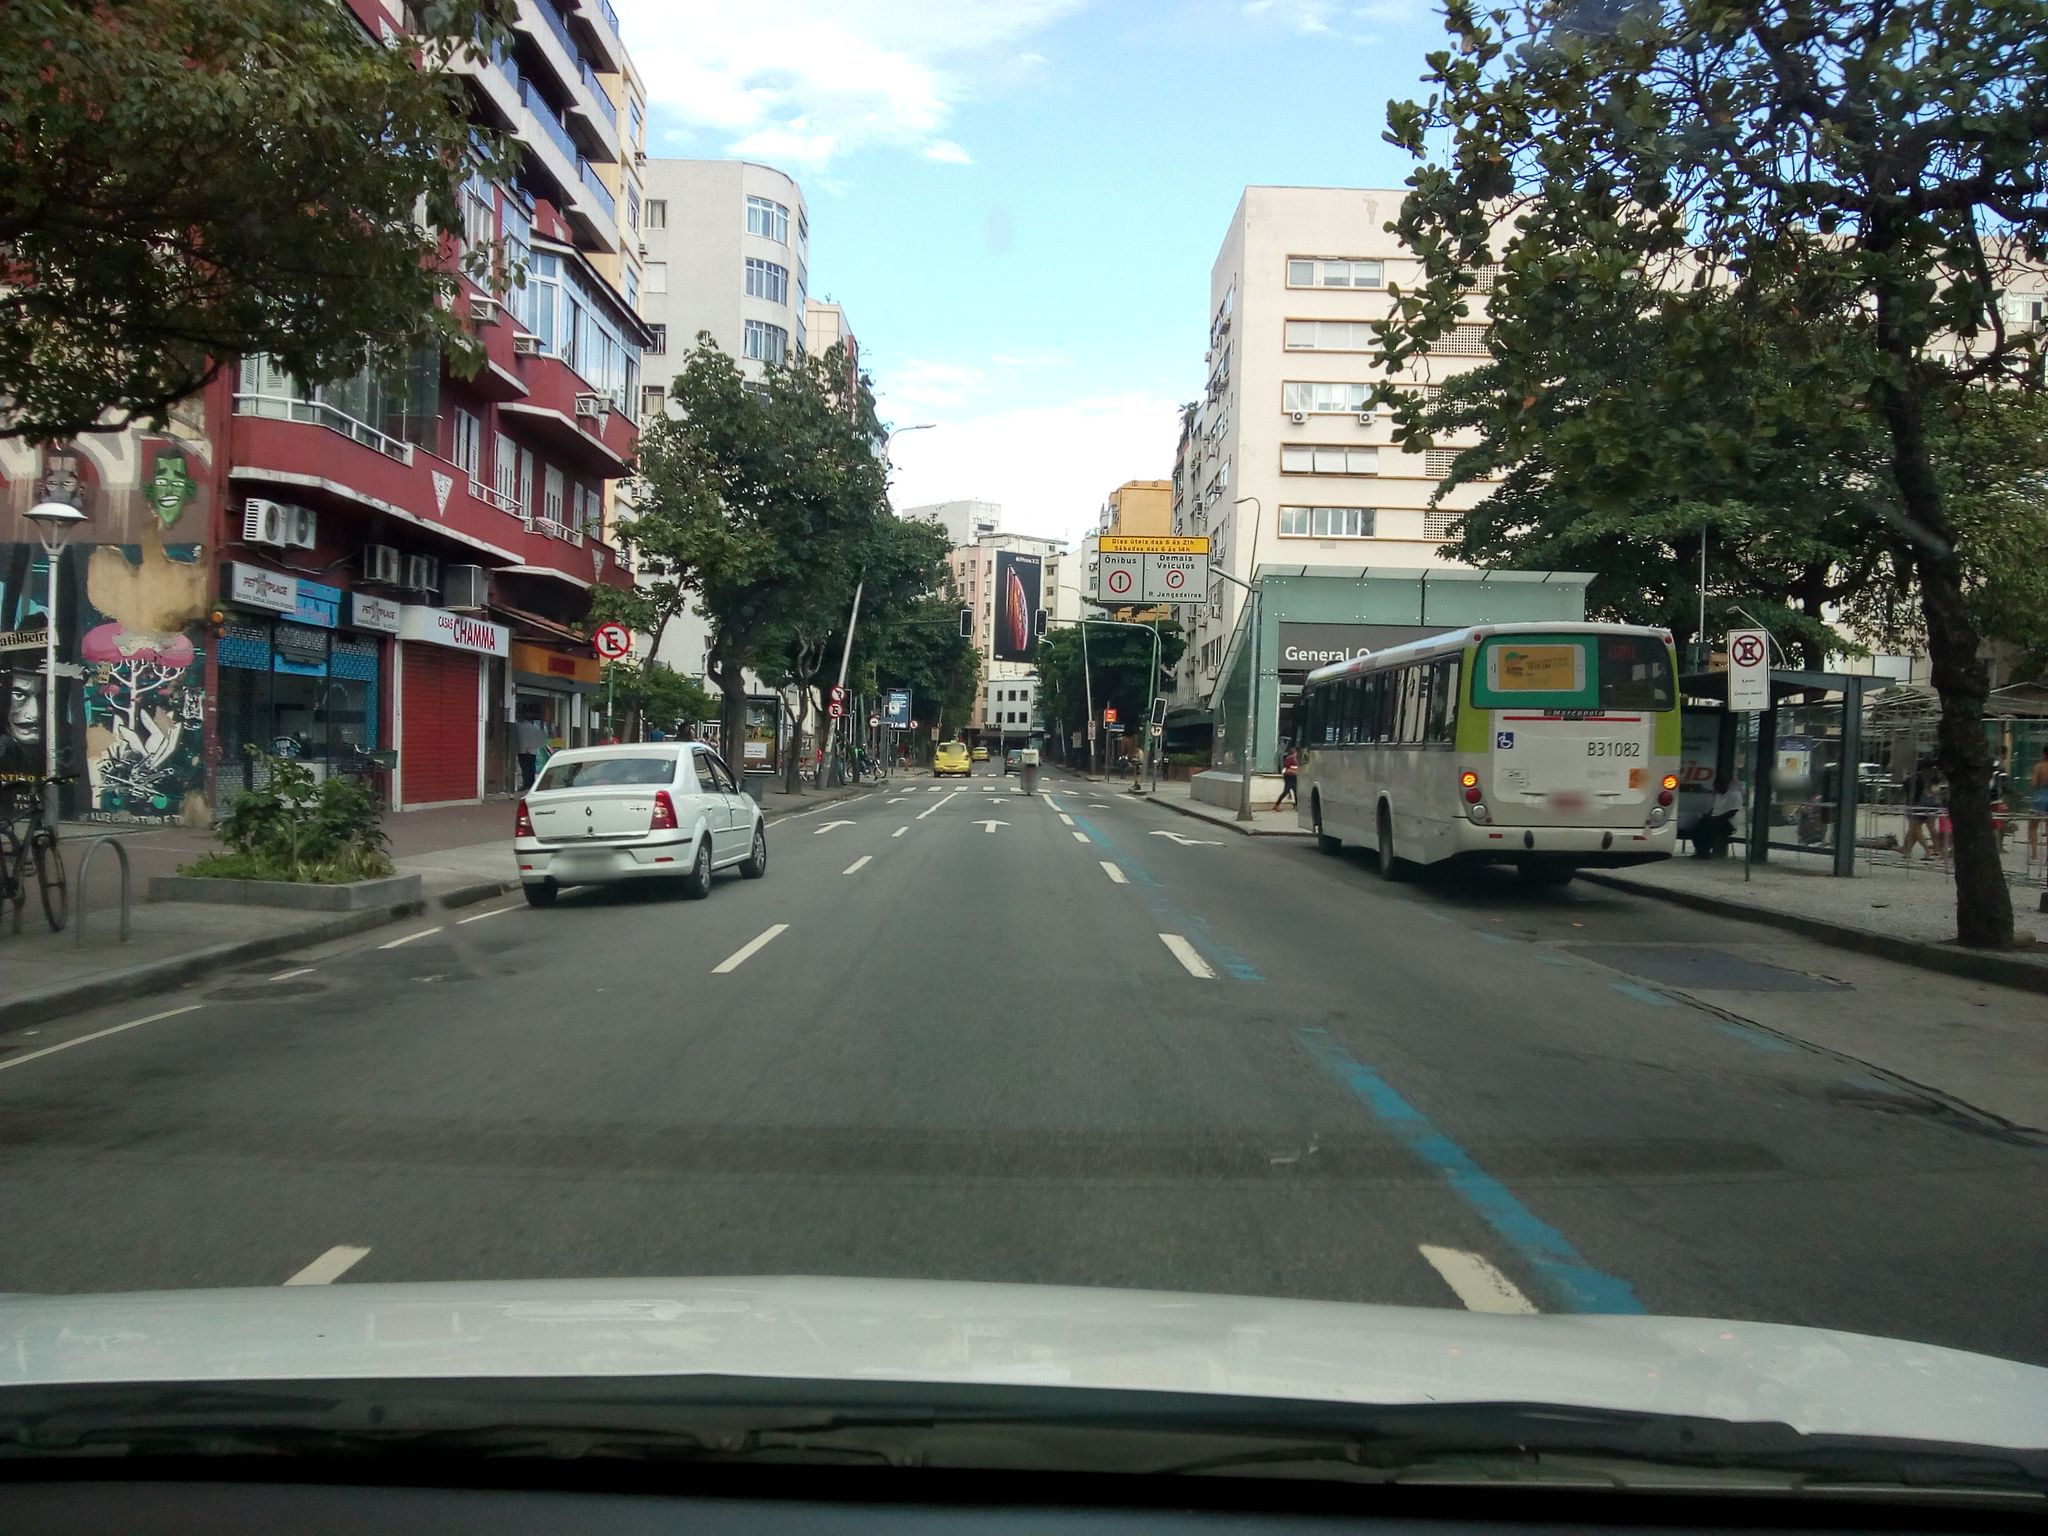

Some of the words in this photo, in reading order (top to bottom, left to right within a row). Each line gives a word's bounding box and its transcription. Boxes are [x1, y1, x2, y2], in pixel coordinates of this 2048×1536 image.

[1104, 554, 1137, 564] Ônibus
[1159, 554, 1193, 562] Demais
[1157, 591, 1202, 599] Jangadeiros
[437, 616, 453, 630] CASAS
[453, 618, 496, 651] CHAMMA
[1285, 646, 1350, 662] General
[1552, 709, 1605, 717] Marcopolo
[1587, 742, 1640, 757] B31082
